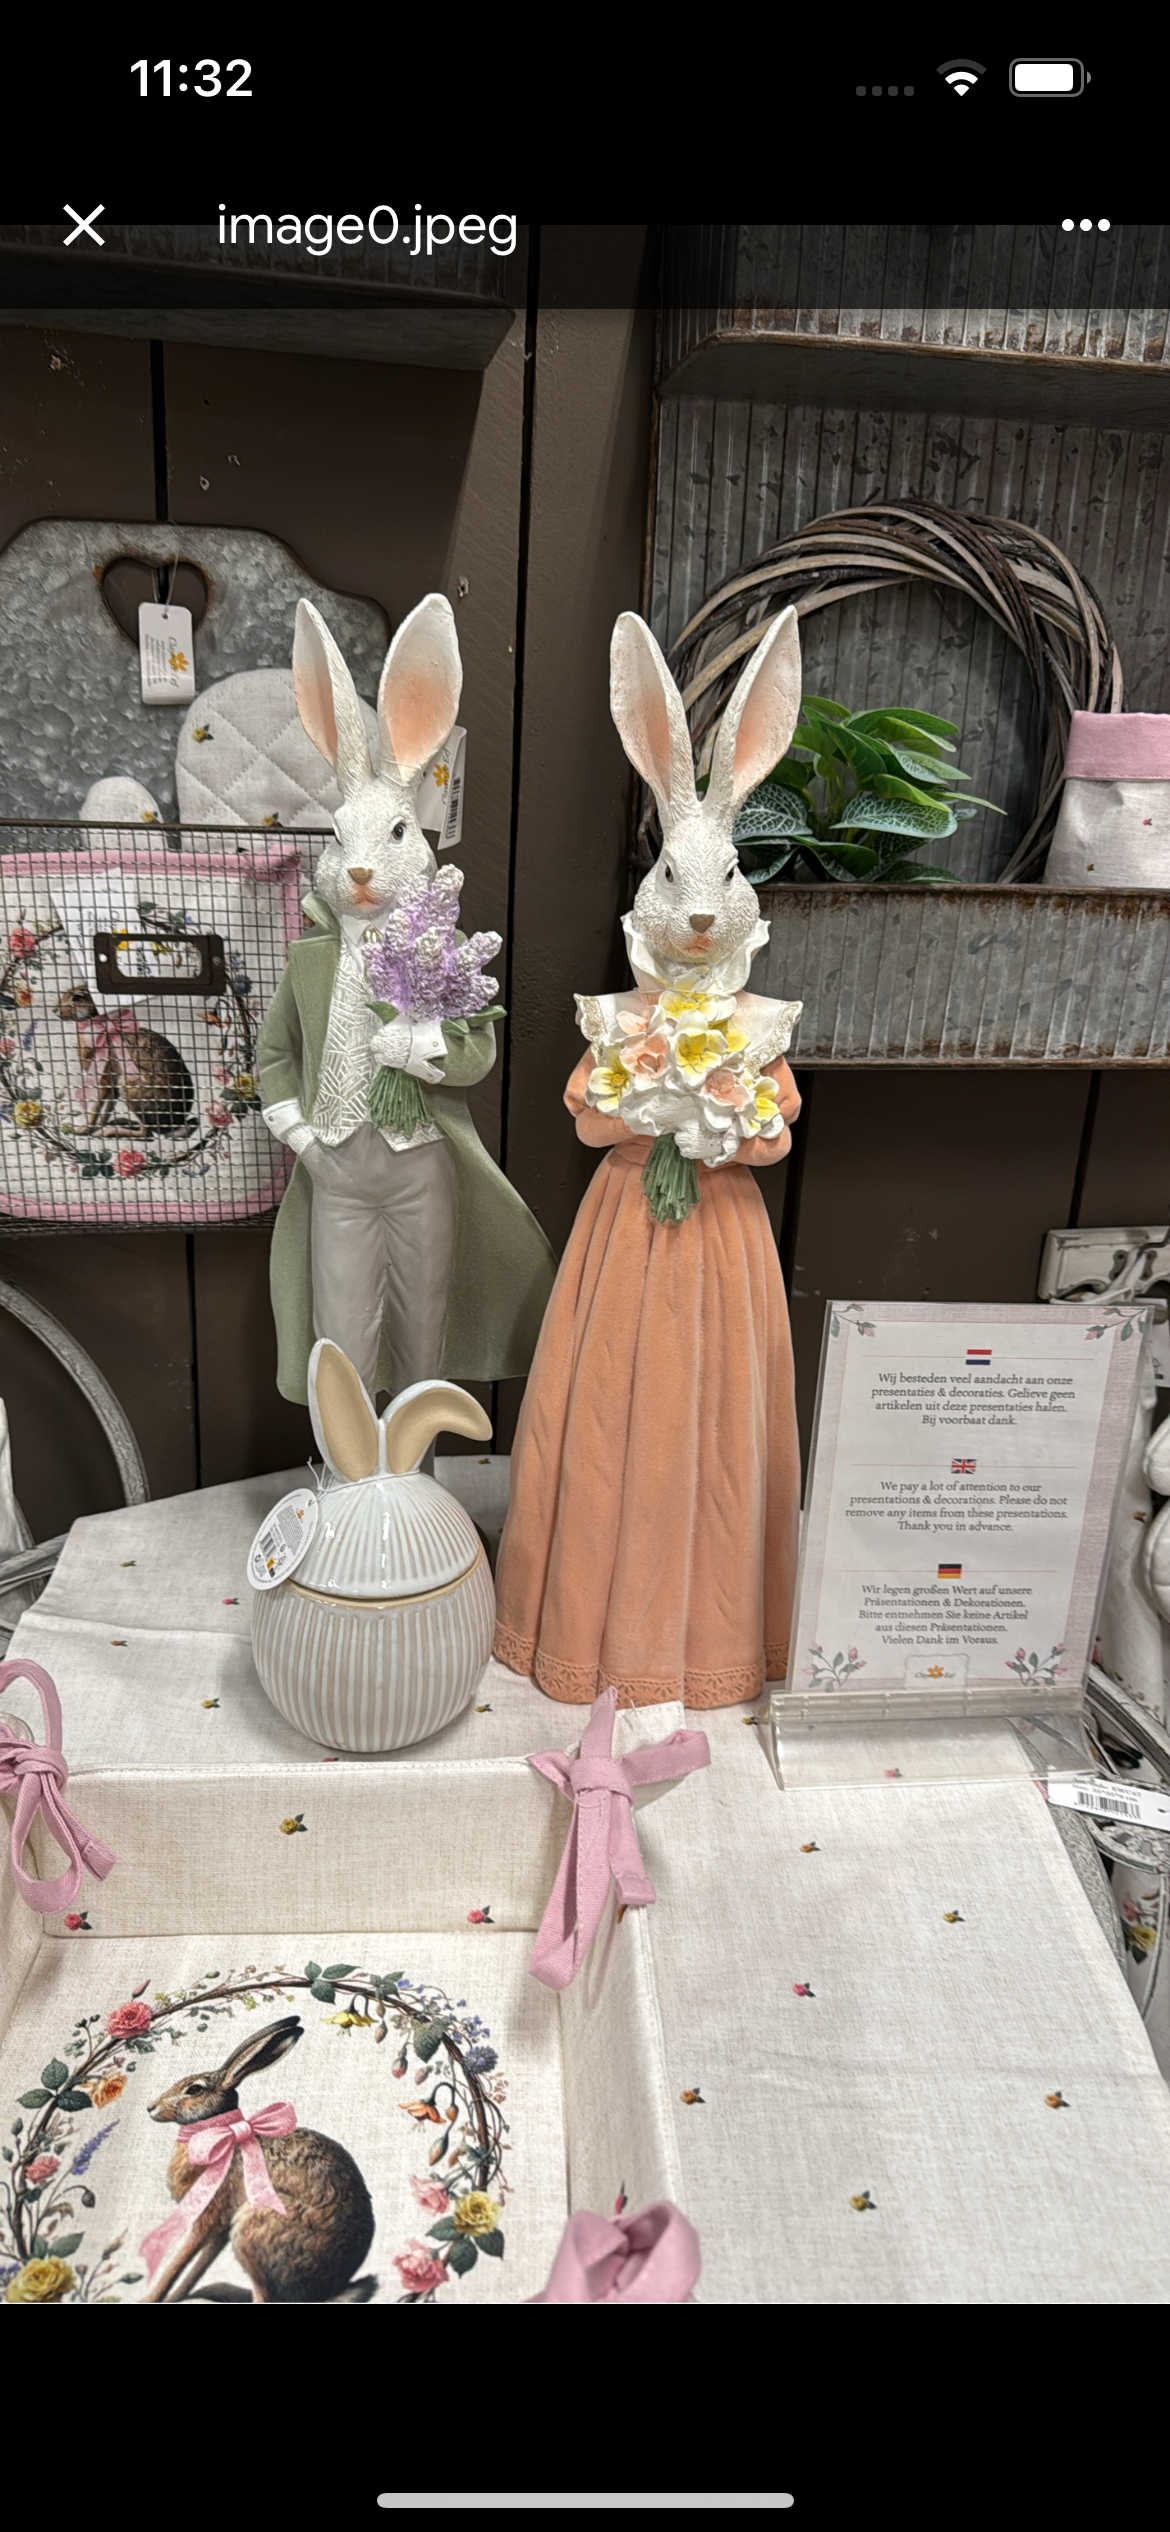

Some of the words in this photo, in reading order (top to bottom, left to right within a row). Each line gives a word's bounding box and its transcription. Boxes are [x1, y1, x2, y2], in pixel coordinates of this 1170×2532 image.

[878, 1373, 897, 1385] Wij
[900, 1373, 947, 1383] besteden
[950, 1374, 971, 1384] veel
[974, 1374, 1023, 1384] aandacht
[1047, 1377, 1073, 1385] onze
[872, 1388, 935, 1399] presentaties
[937, 1389, 946, 1397] &
[949, 1388, 1005, 1398] decoraties.
[1008, 1389, 1048, 1399] Gelieve
[1050, 1391, 1075, 1401] geen
[876, 1401, 922, 1411] artikelen
[926, 1402, 940, 1411] uit
[943, 1401, 967, 1411] deze
[970, 1403, 1033, 1414] presentaties
[1035, 1402, 1067, 1412] halen.
[922, 1415, 936, 1427] Bij
[939, 1415, 985, 1425] voorbaat
[988, 1416, 1017, 1425] dank.
[881, 1482, 897, 1491] We
[900, 1484, 918, 1494] pay
[930, 1482, 944, 1491] lot
[949, 1481, 959, 1491] of
[959, 1483, 1007, 1492] attention
[1010, 1483, 1020, 1492] to
[850, 1496, 920, 1506] presentations
[923, 1496, 931, 1504] &
[934, 1495, 996, 1504] decorations.
[999, 1496, 1030, 1505] Please
[1034, 1496, 1047, 1505] do
[1049, 1497, 1067, 1505] not
[887, 1510, 907, 1520] any
[909, 1509, 937, 1518] items
[939, 1508, 965, 1518] from
[968, 1509, 994, 1518] these
[996, 1509, 1068, 1520] presentations.
[898, 1521, 930, 1530] Thank
[933, 1524, 953, 1533] you
[956, 1522, 965, 1531] in
[968, 1522, 1013, 1531] advance.
[862, 1585, 881, 1594] Wir
[883, 1585, 910, 1596] legen
[913, 1585, 949, 1596] großen
[952, 1586, 977, 1594] Wert
[979, 1585, 997, 1594] auf
[864, 1598, 940, 1606] Präsentationen
[942, 1598, 951, 1606] &
[954, 1598, 1025, 1607] Dekorationen.
[859, 1610, 883, 1619] Bitte
[885, 1611, 942, 1619] entnehmen
[945, 1611, 961, 1619] Sie
[963, 1611, 991, 1620] keine
[992, 1611, 1028, 1620] Artikel
[876, 1624, 893, 1632] aus
[895, 1623, 927, 1632] diesen
[930, 1623, 1007, 1632] Präsentationen.
[882, 1636, 914, 1644] Vielen
[916, 1636, 943, 1644] Dank
[946, 1636, 959, 1644] im
[962, 1636, 998, 1644] Voraus.
